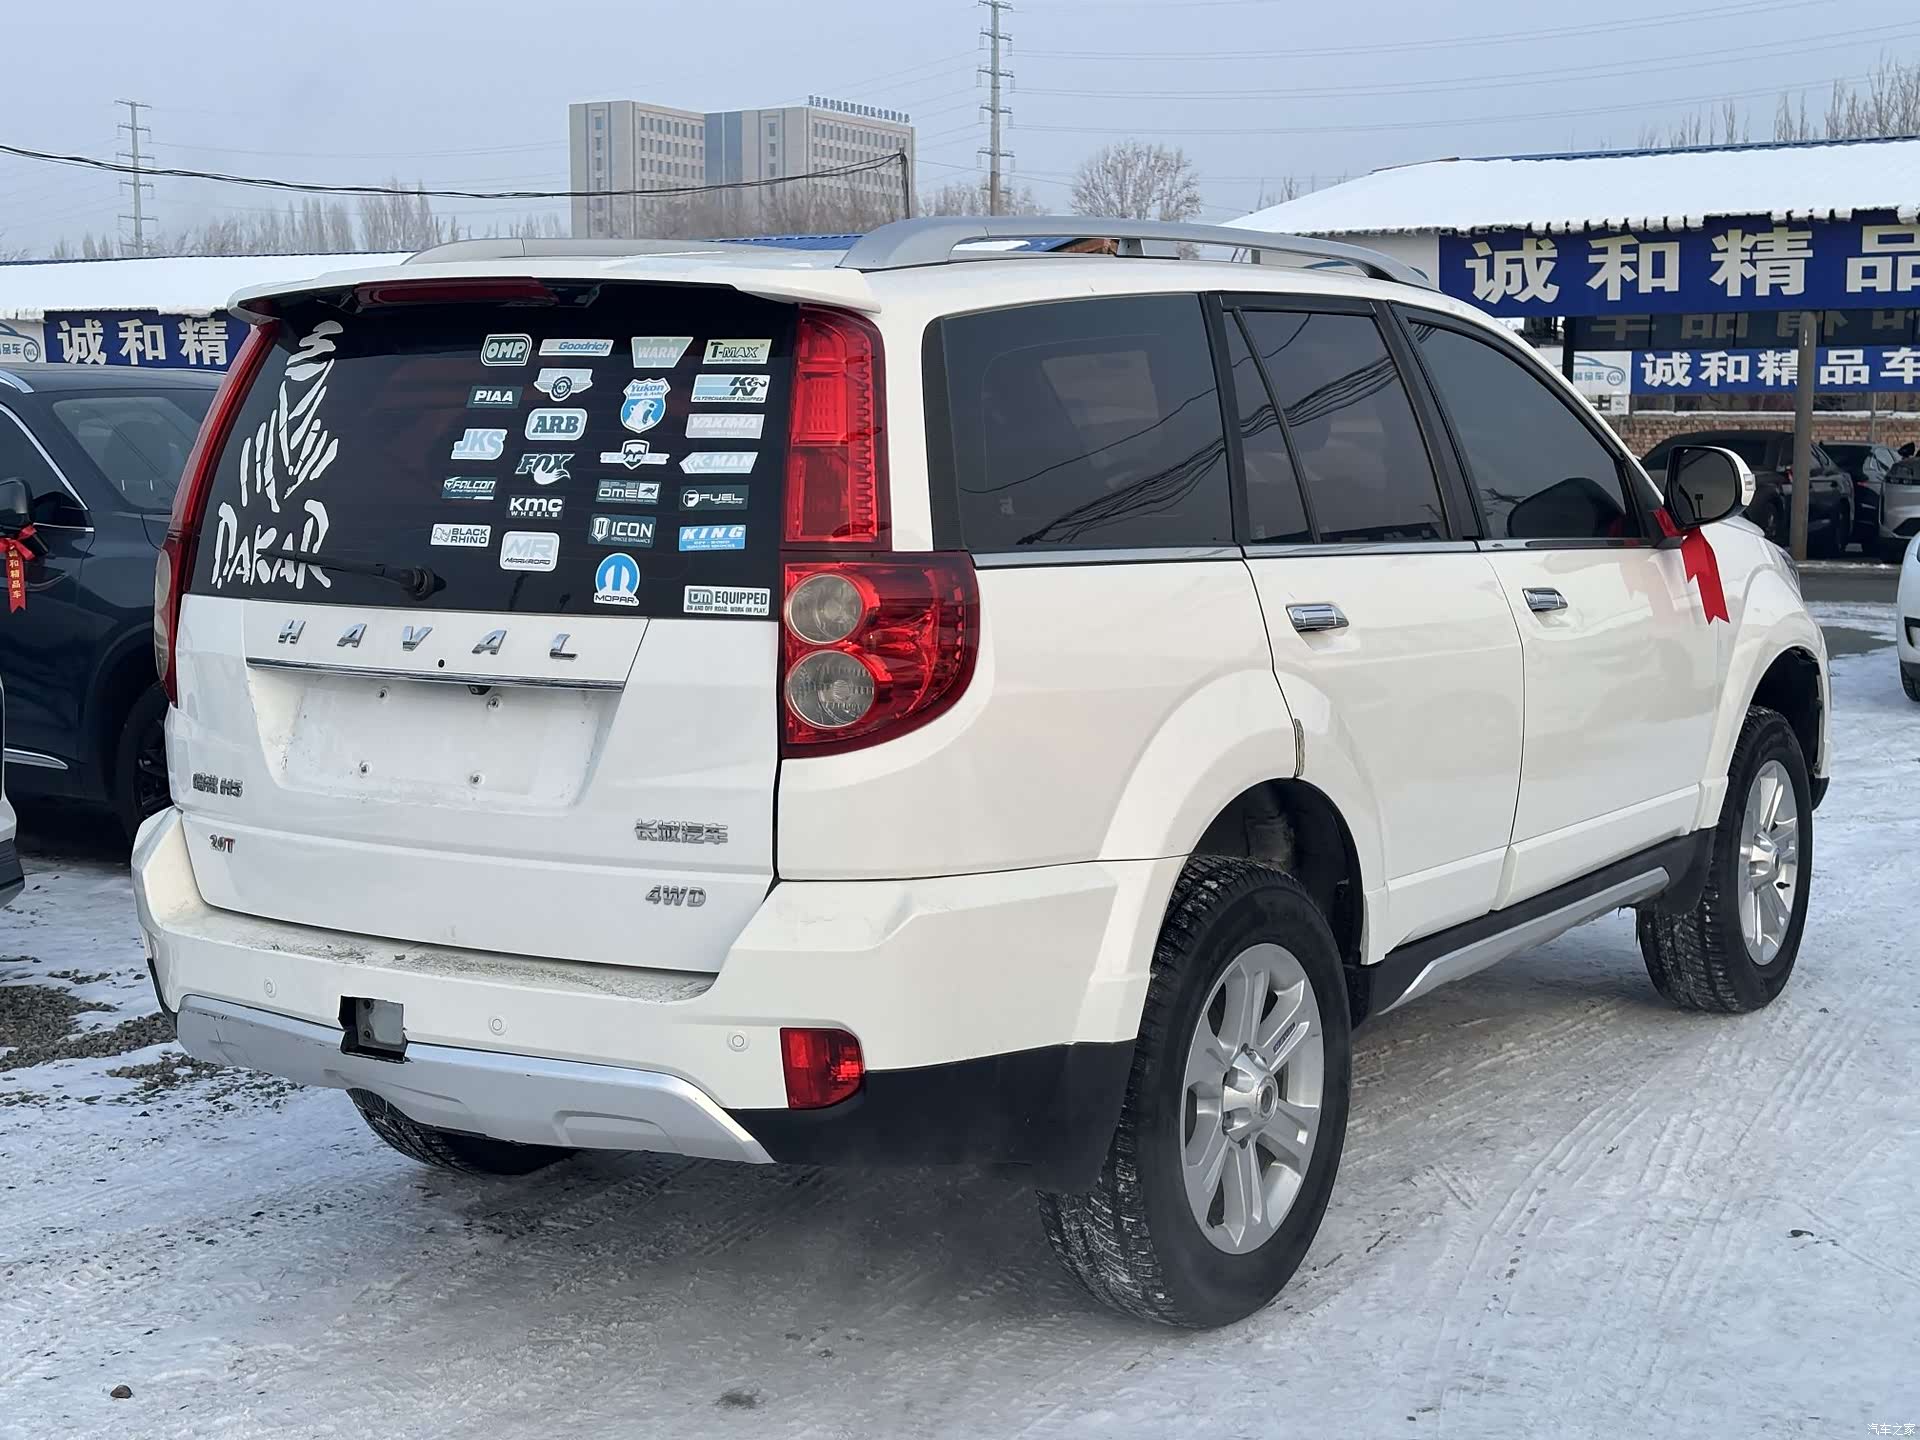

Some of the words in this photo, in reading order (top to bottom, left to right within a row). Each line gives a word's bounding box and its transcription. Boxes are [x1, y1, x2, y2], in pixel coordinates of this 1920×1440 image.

[1465, 225, 1920, 305] 诚和精品
[0, 343, 21, 355] 品车
[57, 318, 229, 365] 诚和精
[558, 341, 609, 351] Goodrich
[637, 346, 678, 359] WARN
[710, 341, 759, 358] T-MAX
[1640, 346, 1920, 387] 诚和精品车
[631, 384, 665, 392] Yukon
[474, 390, 513, 402] PIAA
[532, 415, 580, 434] ARB
[455, 430, 504, 454] JKS
[515, 453, 575, 475] FOX
[452, 480, 496, 489] FALCON
[599, 488, 637, 498] OME
[700, 493, 745, 501] FUEL
[452, 527, 489, 536] BLACK
[611, 521, 653, 538] ICON
[682, 527, 744, 541] KING
[211, 499, 331, 589] DAKAR
[450, 535, 487, 544] RHINO
[595, 594, 635, 603] MOPAR
[714, 591, 768, 605] EQUIPPED
[278, 619, 579, 661] HAVAL
[220, 778, 243, 797] H5
[634, 818, 728, 845] 长城汽车
[645, 884, 707, 907] 4WD
